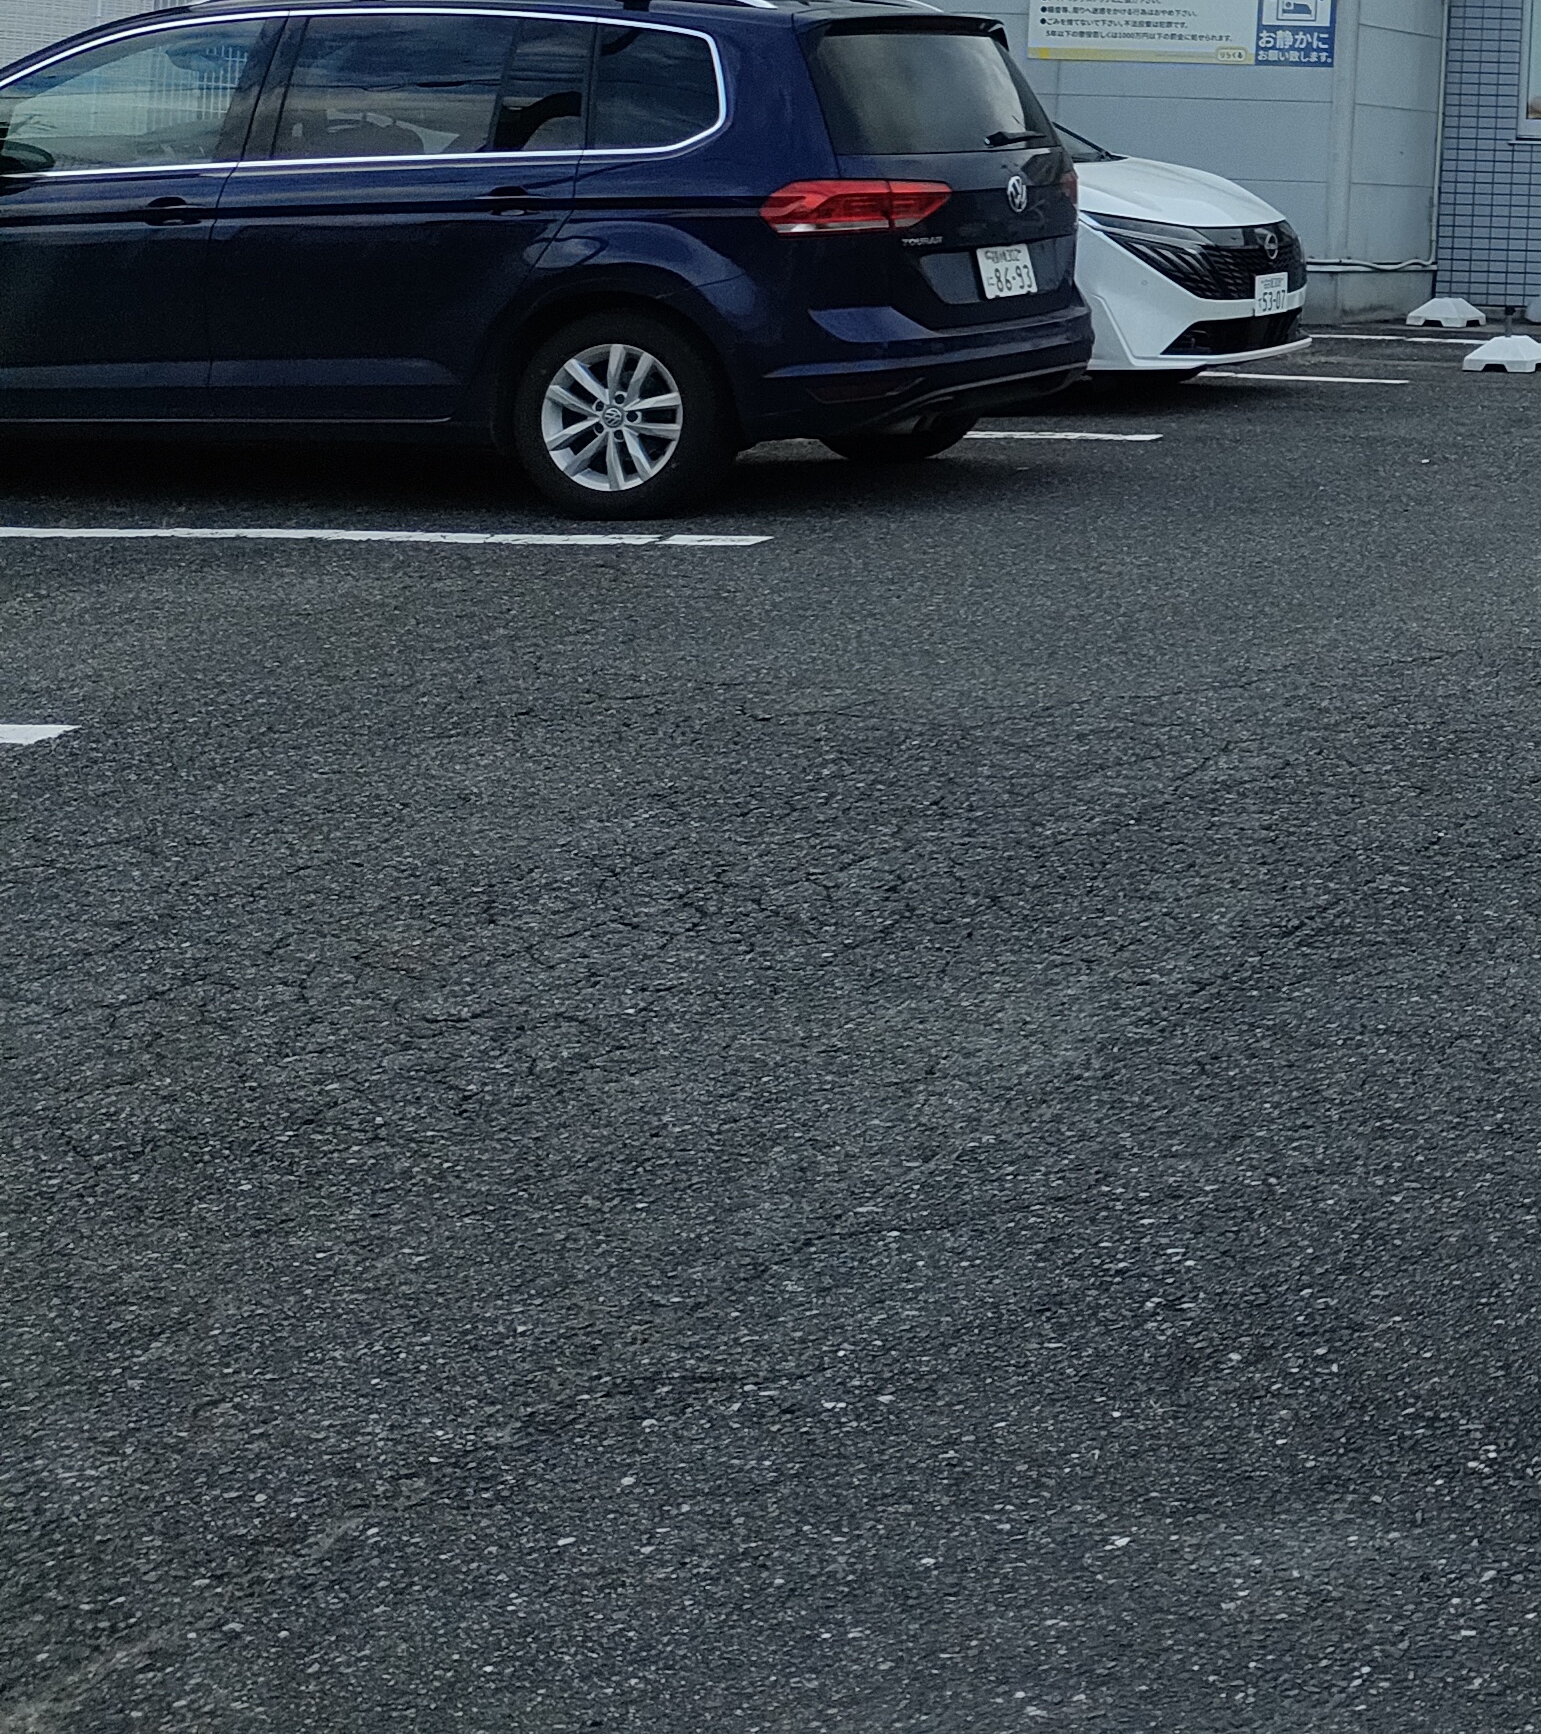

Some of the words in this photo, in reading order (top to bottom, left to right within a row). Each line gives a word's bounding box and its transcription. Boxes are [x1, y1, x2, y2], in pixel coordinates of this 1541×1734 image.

[1258, 30, 1329, 49] お静かに
[1258, 50, 1332, 63] お願い致します。
[994, 264, 1032, 293] 86-93
[1263, 290, 1285, 311] 53-07
